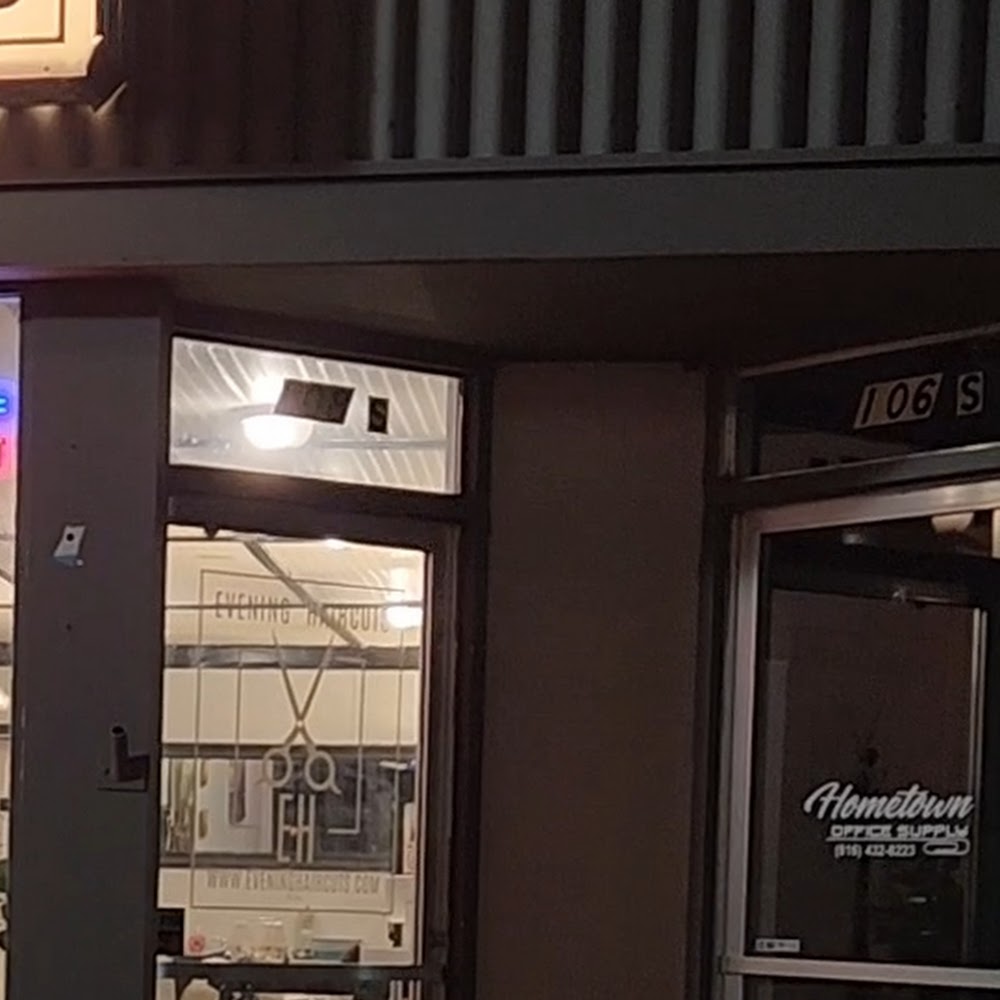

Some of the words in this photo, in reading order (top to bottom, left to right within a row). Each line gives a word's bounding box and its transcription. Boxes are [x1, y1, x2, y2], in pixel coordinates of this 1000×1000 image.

[860, 377, 937, 425] 106
[960, 374, 980, 412] S
[215, 591, 290, 625] EVENING
[803, 781, 974, 820] Hometown
[830, 824, 892, 838] OFFICE
[896, 824, 969, 838] SUPPLY
